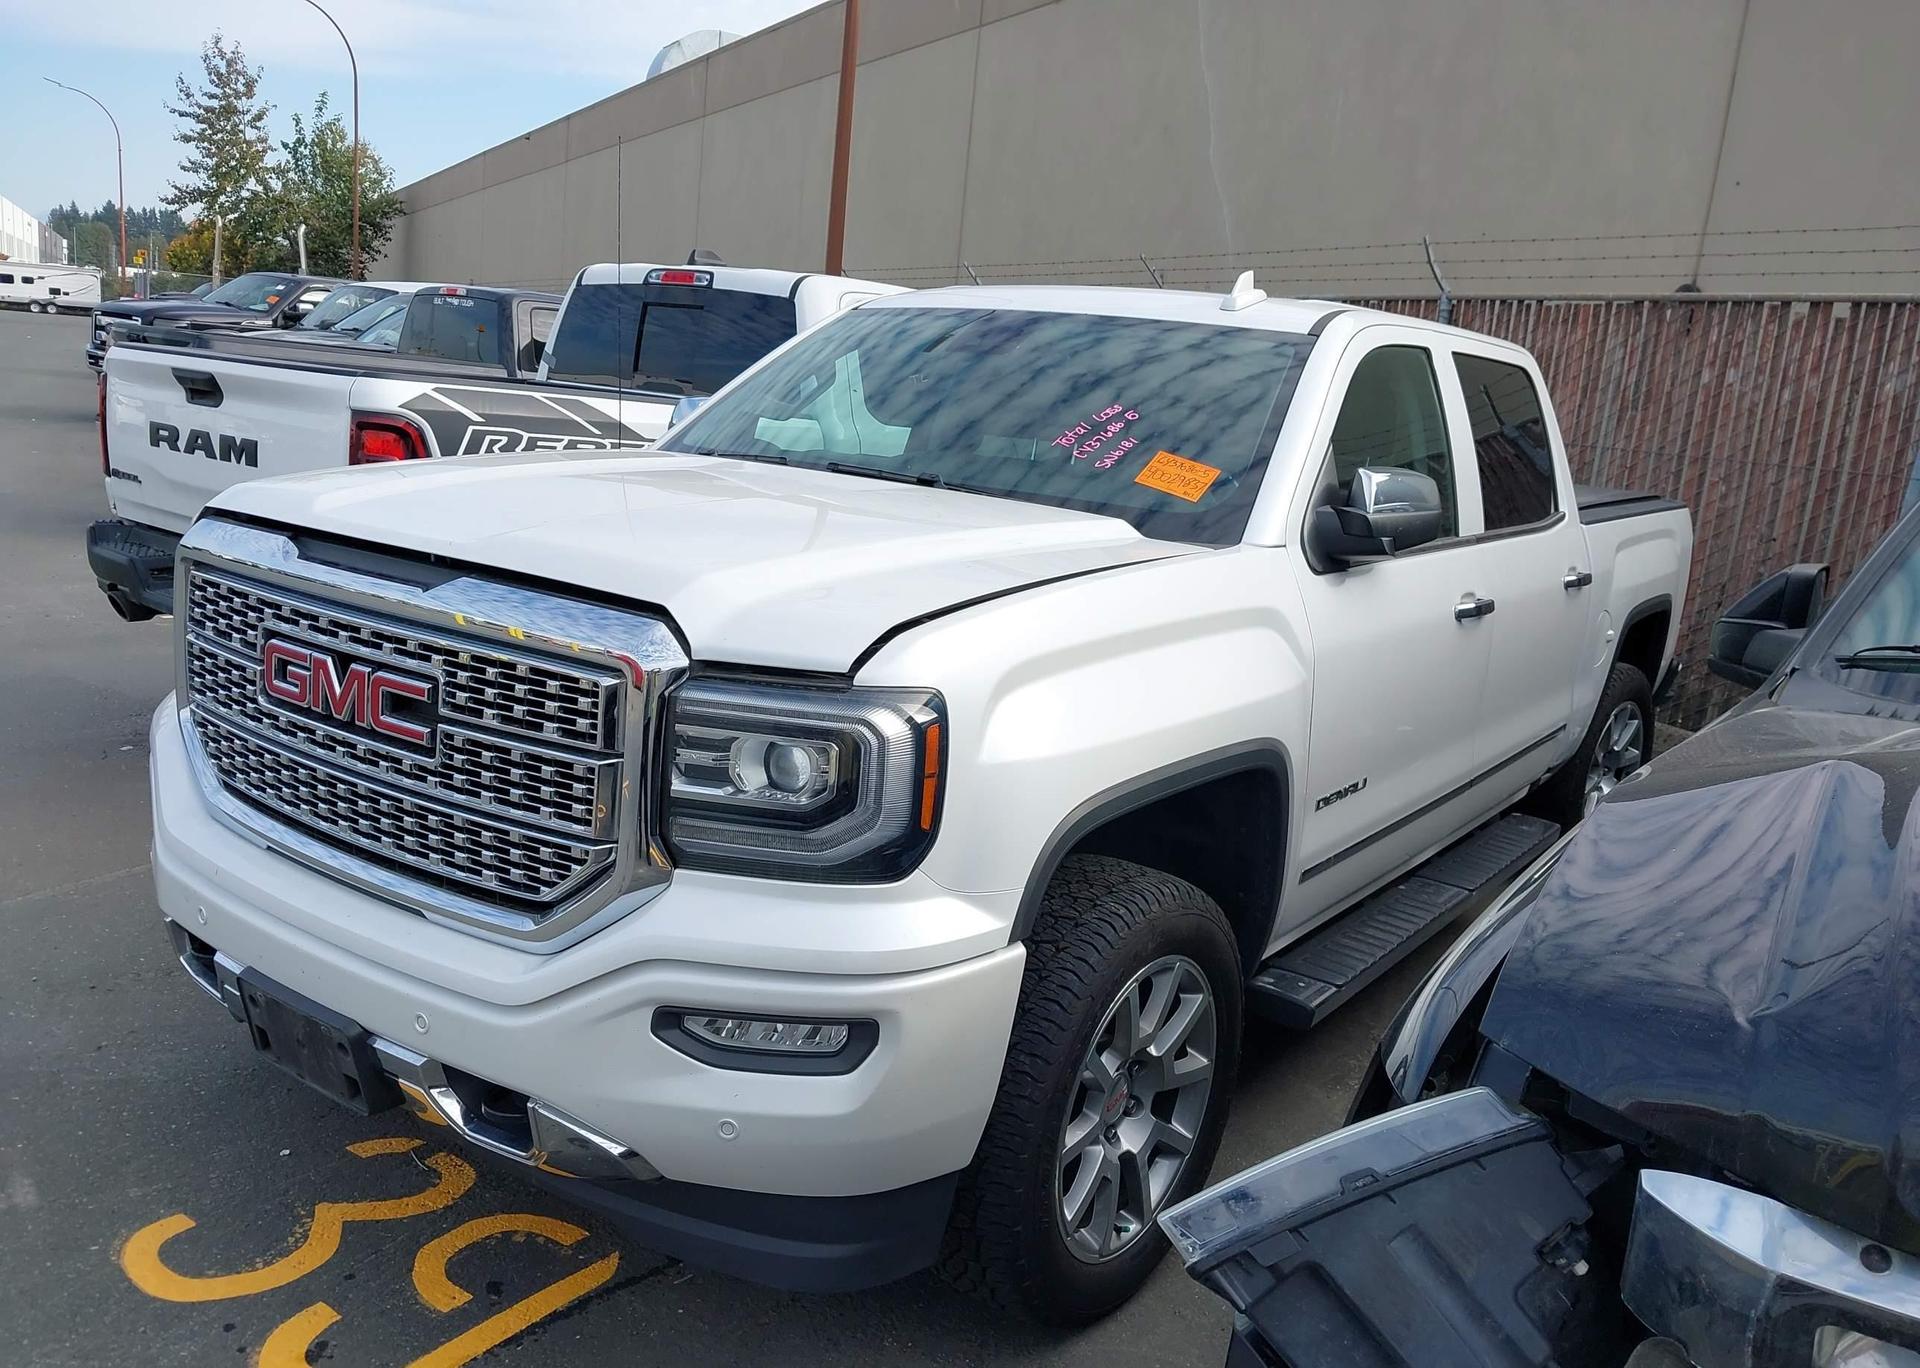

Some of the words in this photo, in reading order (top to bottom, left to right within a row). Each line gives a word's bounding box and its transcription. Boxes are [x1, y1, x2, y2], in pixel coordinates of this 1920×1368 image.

[149, 420, 259, 468] RAM
[1051, 421, 1092, 447] Total
[1094, 437, 1139, 469] SN6181
[264, 638, 434, 747] GMC
[1314, 776, 1368, 813] DENALI
